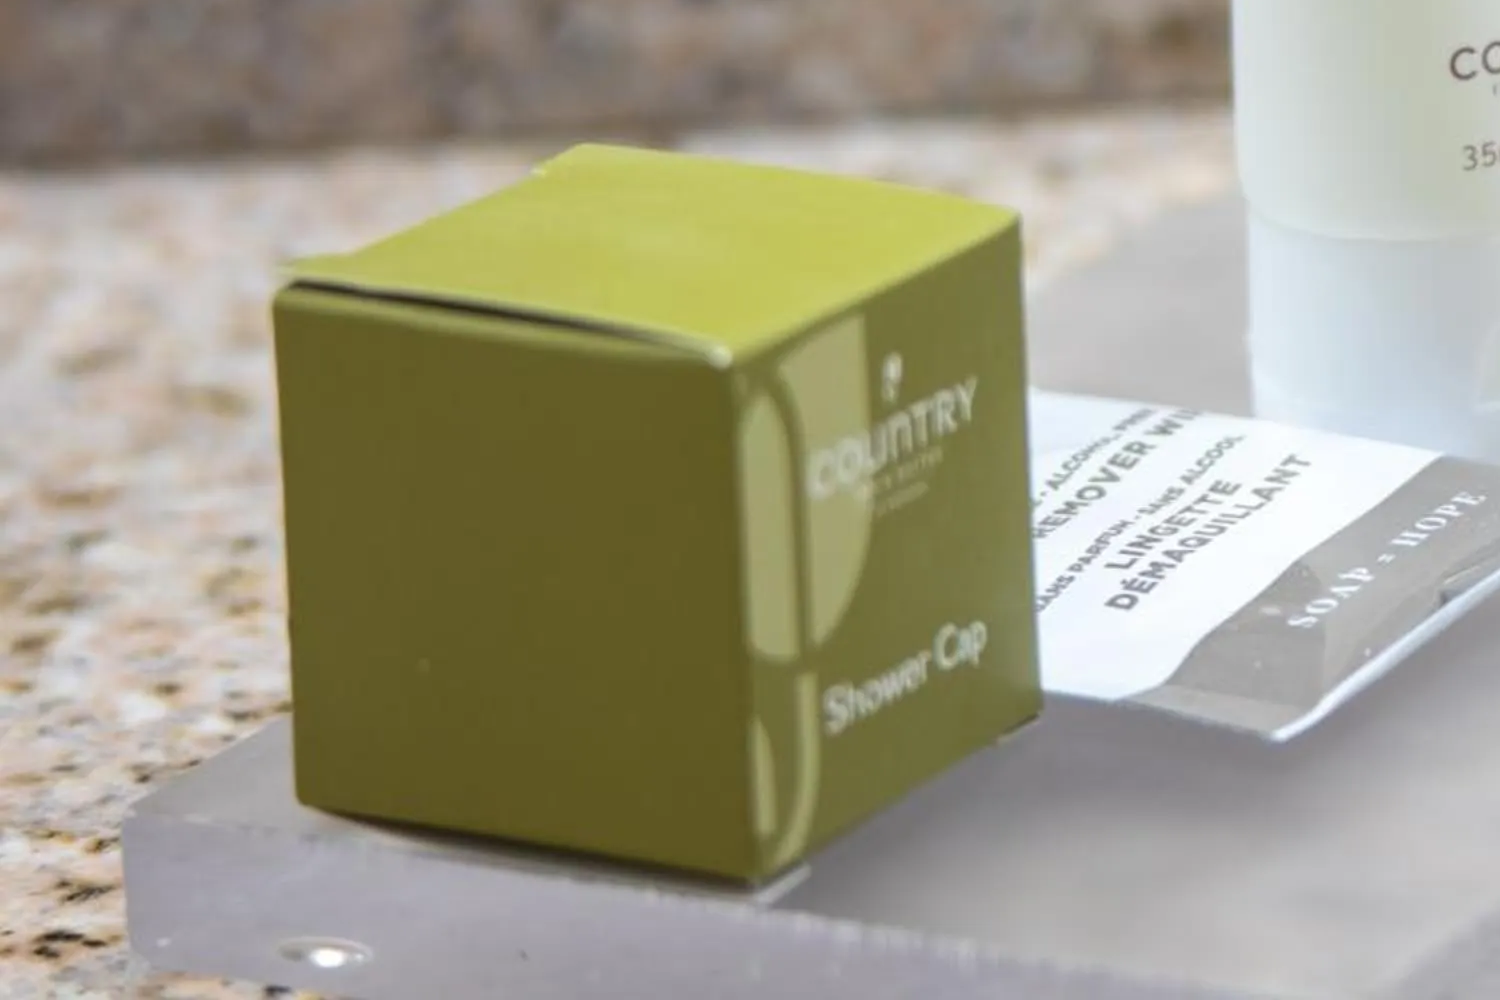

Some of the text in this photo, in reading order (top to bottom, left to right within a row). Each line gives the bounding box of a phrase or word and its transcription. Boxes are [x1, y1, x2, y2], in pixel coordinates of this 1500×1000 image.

[1032, 441, 1157, 538] REMOVER
[1066, 520, 1135, 573] PARFUM
[1179, 434, 1246, 485] ALCOOL
[1103, 479, 1242, 571] LINGETTE
[1103, 453, 1312, 611] DÉMAQUILLANT
[1286, 566, 1375, 628] SOAP
[1388, 490, 1488, 546] HOPE
[822, 620, 989, 737] Shower Cap
